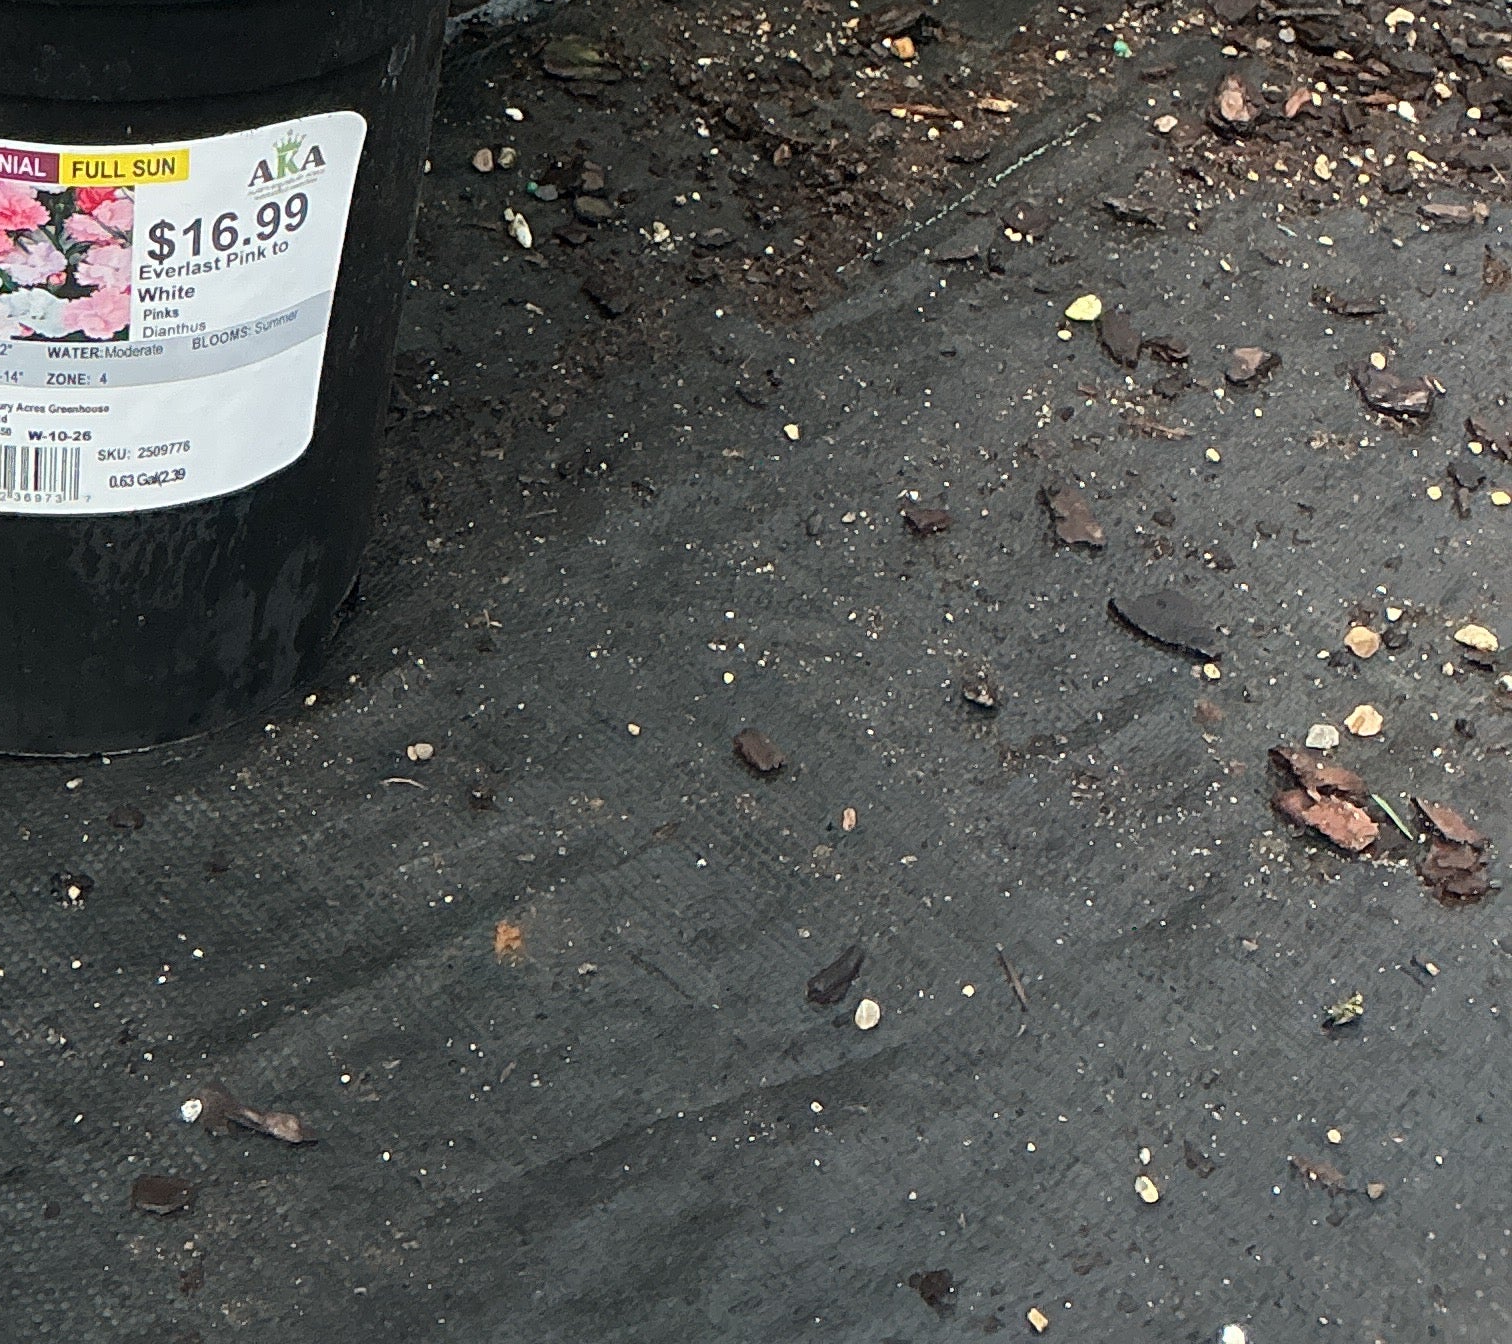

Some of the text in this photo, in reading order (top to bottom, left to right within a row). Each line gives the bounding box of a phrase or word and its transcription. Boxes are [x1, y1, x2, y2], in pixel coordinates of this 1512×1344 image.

[71, 156, 176, 179] FULL SUN
[247, 144, 327, 188] AKA
[146, 191, 309, 266] $16.99
[138, 239, 289, 281] Everlast Pink to
[137, 285, 196, 304] White
[143, 307, 180, 322] Pinks
[142, 321, 207, 340] Dianthus
[191, 326, 252, 351] BLOOMS:
[254, 309, 300, 336] Summer
[46, 372, 91, 386] ZONE:
[99, 372, 108, 385] 4
[16, 402, 47, 414] Acres
[48, 403, 110, 414] Greenhouse
[27, 430, 92, 442] W-10-26
[96, 447, 131, 462] SKU:
